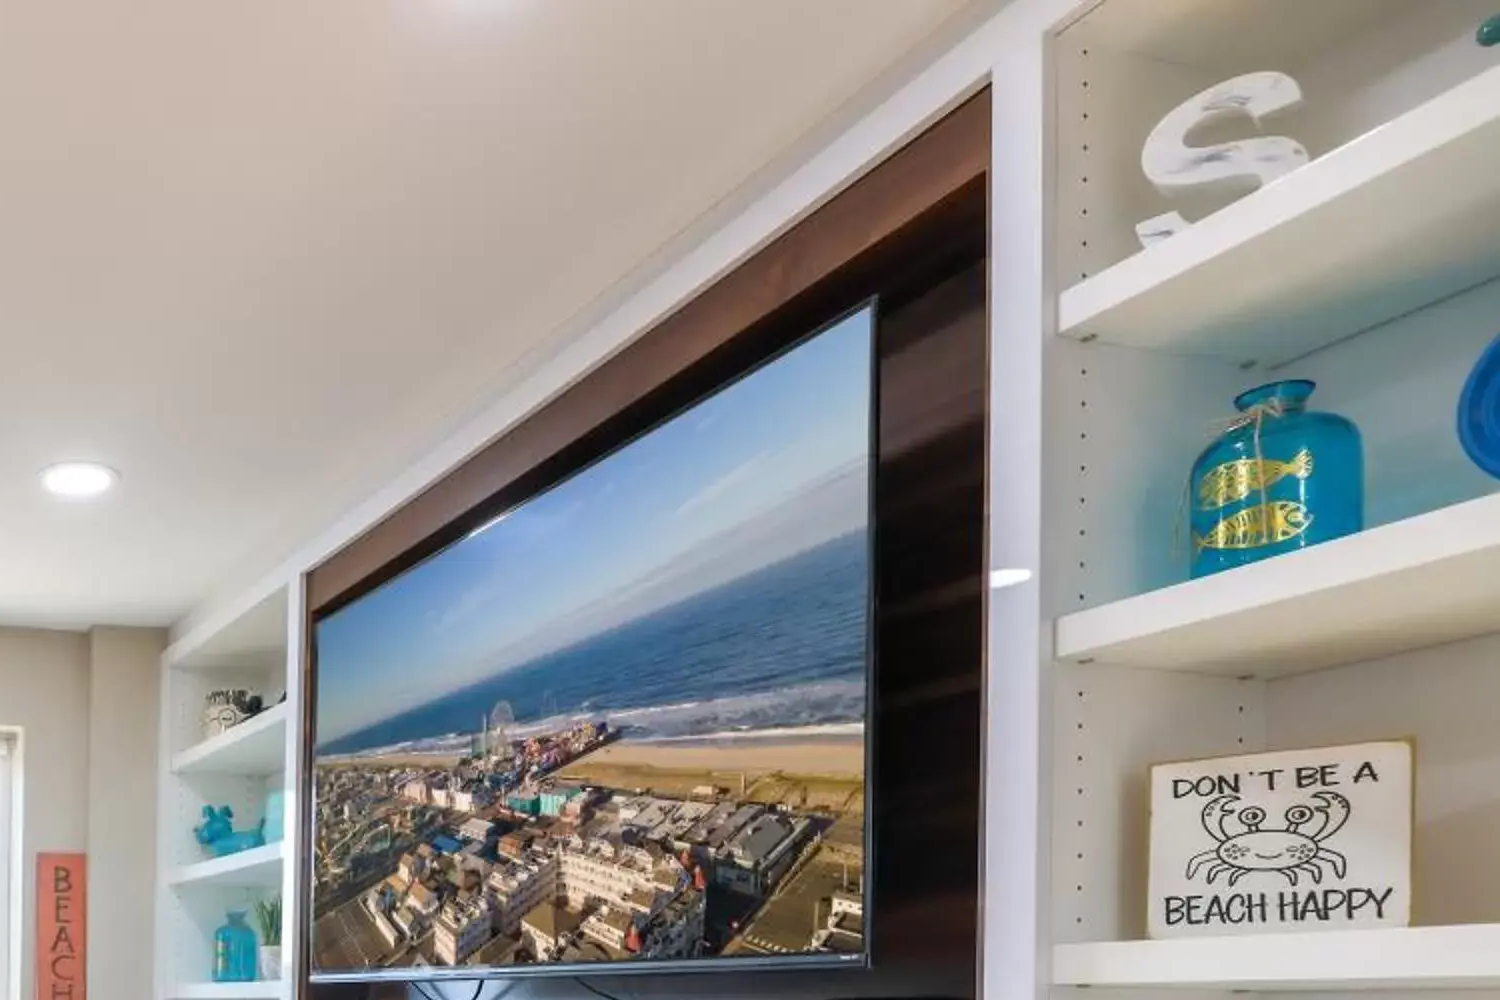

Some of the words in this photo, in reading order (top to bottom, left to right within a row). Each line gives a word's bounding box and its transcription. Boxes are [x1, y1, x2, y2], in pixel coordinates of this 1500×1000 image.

[1135, 71, 1310, 249] S
[1172, 770, 1284, 799] DON'T
[1295, 764, 1341, 788] BE
[1353, 761, 1379, 783] A
[1164, 893, 1266, 925] BEACH
[1279, 887, 1393, 921] HAPPY
